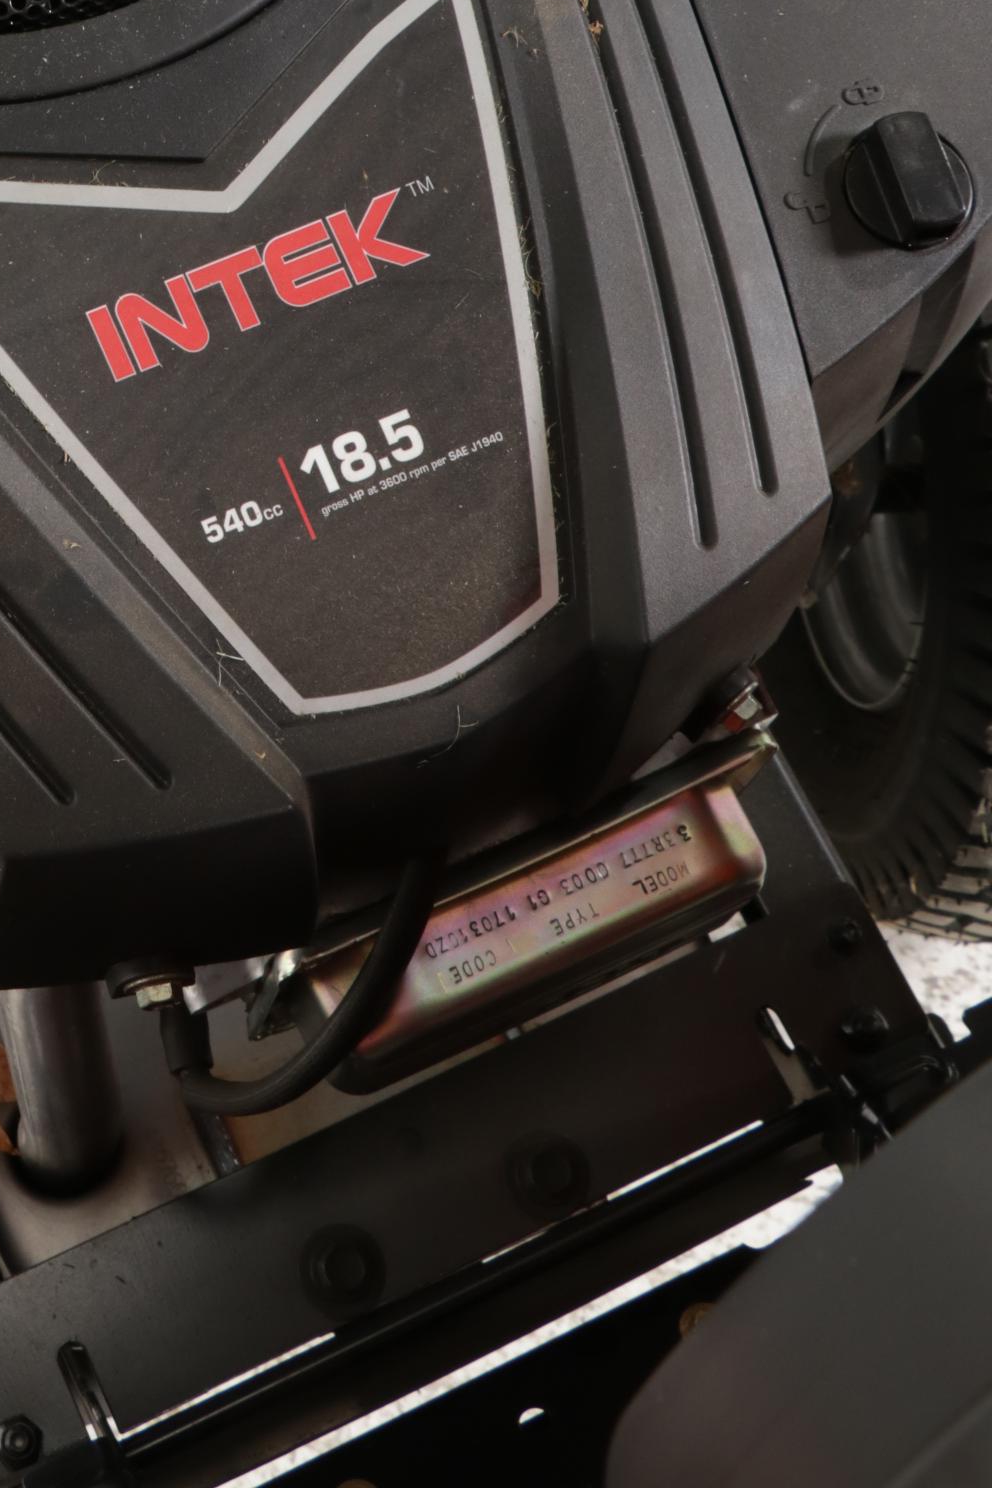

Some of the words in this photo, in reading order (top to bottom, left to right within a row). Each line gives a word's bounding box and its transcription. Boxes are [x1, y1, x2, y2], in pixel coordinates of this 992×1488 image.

[85, 187, 432, 384] INTEK
[300, 408, 425, 494] 18.5
[321, 497, 350, 518] gross
[349, 489, 365, 504] HP
[367, 485, 380, 497] at
[379, 471, 408, 491] 3600
[409, 464, 430, 480] rpm
[431, 455, 448, 471] per
[448, 446, 470, 462] SAE
[471, 431, 505, 453] J1940
[632, 861, 691, 895] MODEL
[550, 903, 600, 936] TYPE
[448, 949, 497, 985] CODE
